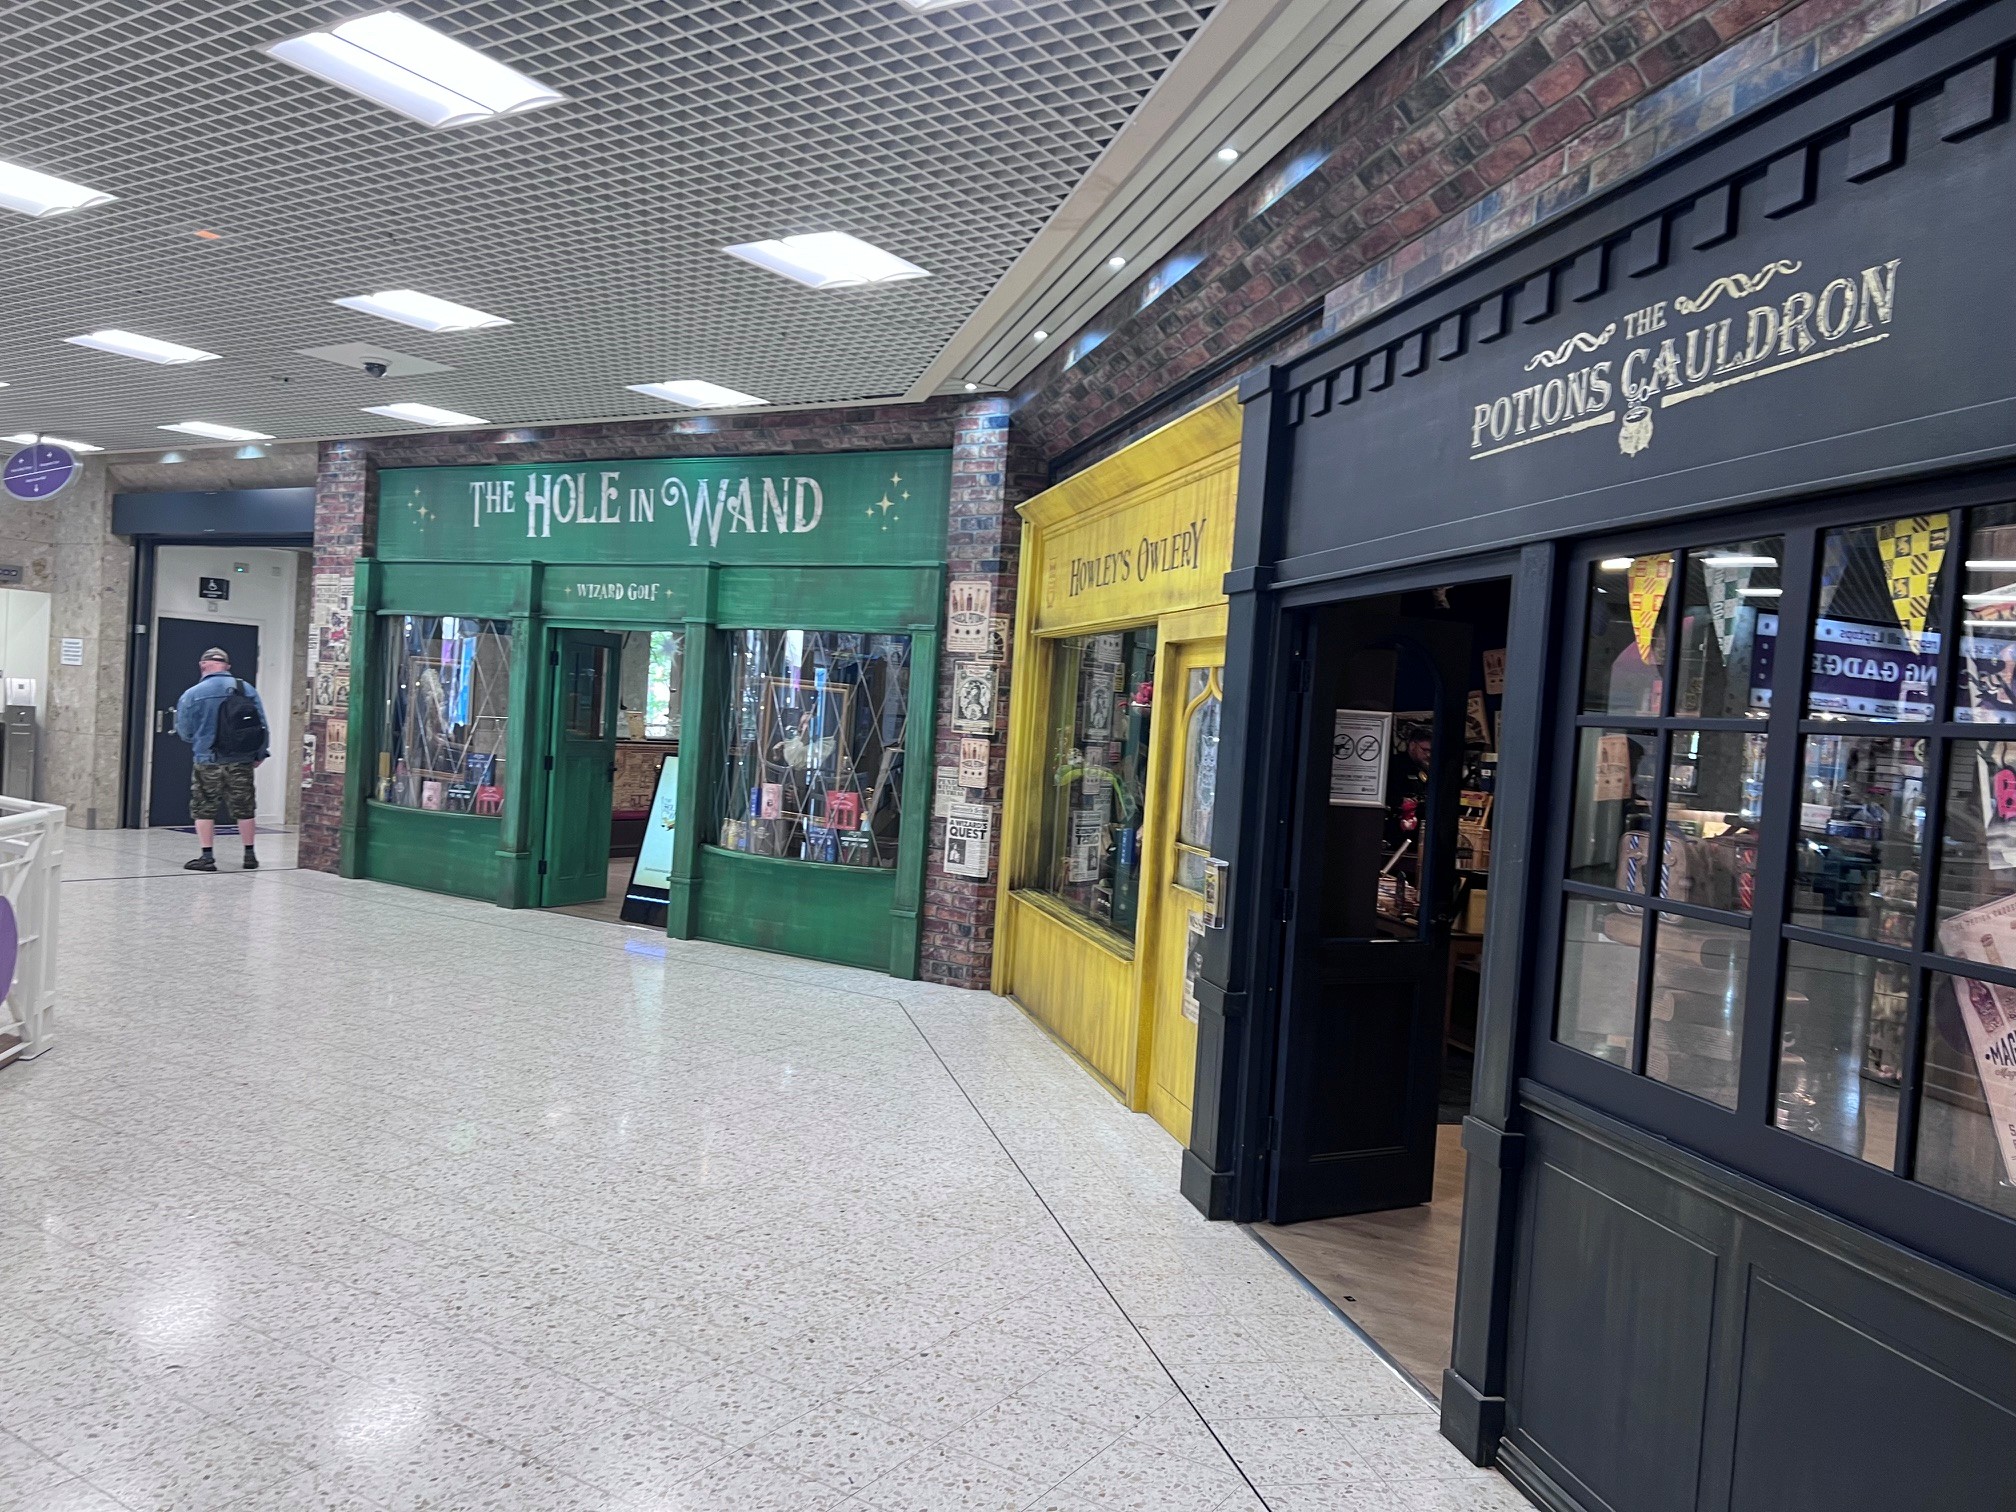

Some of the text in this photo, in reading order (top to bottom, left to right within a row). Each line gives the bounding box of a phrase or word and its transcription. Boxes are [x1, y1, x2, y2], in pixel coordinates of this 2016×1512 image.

[1622, 300, 1668, 341] THE
[1470, 257, 1902, 449] POTIONS CAULDRON
[469, 471, 825, 549] THE HOLE IN WAND
[1069, 548, 1131, 598] HOWLEY'S
[1136, 518, 1207, 583] OWLERY
[577, 582, 661, 602] WIZARD GOLF
[949, 826, 988, 840] QUEST
[956, 820, 988, 830] WIZARD'S
